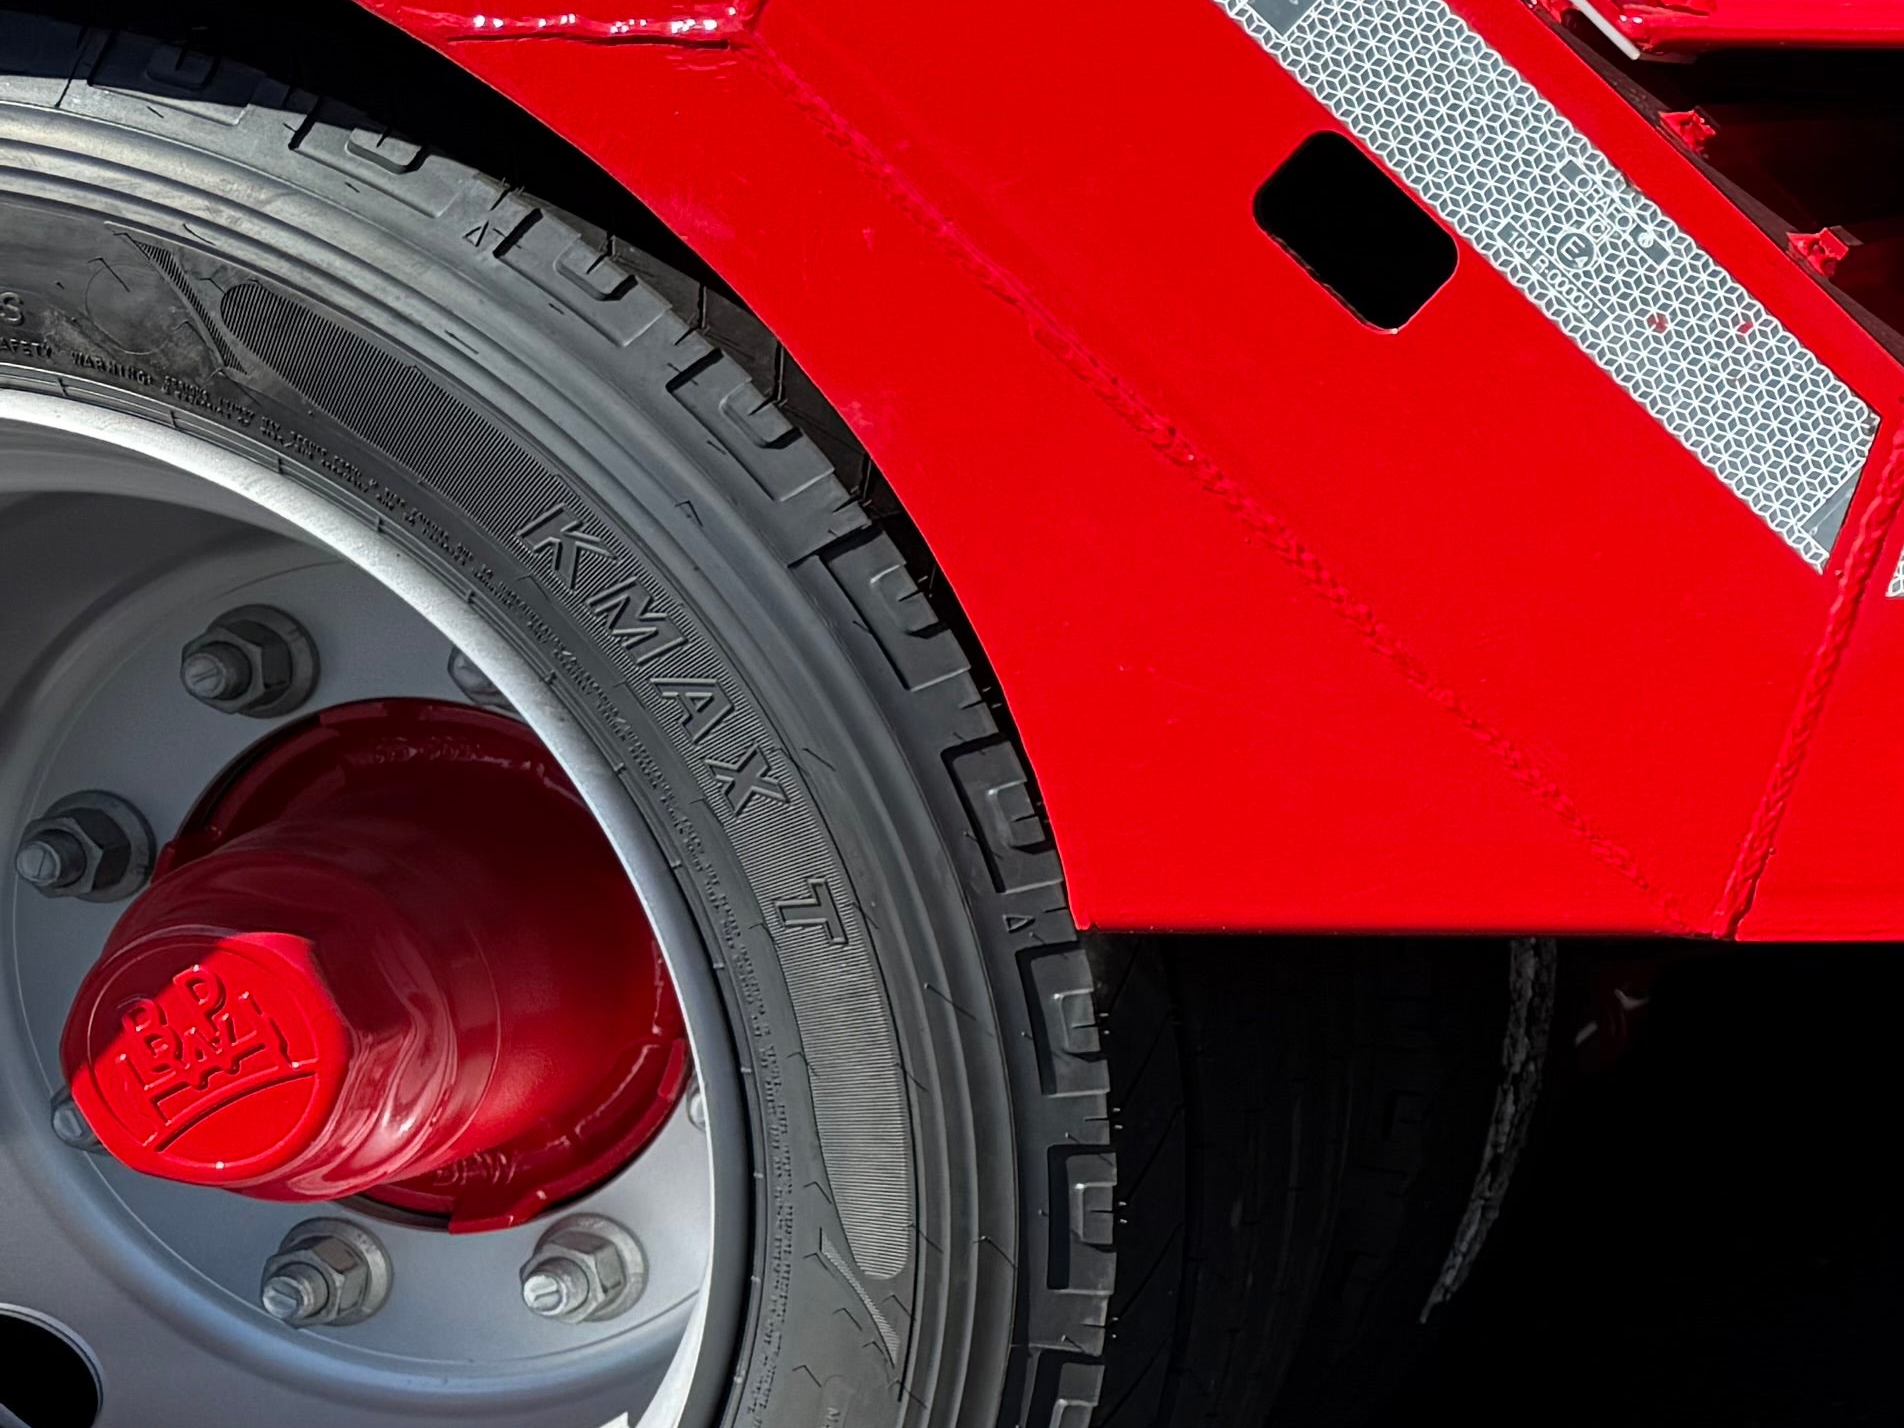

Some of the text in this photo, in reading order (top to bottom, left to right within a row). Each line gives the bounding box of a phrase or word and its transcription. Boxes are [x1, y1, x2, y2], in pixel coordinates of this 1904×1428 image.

[1507, 231, 1601, 322] 104 R-000001
[515, 502, 792, 818] KMAX
[774, 876, 849, 945] T
